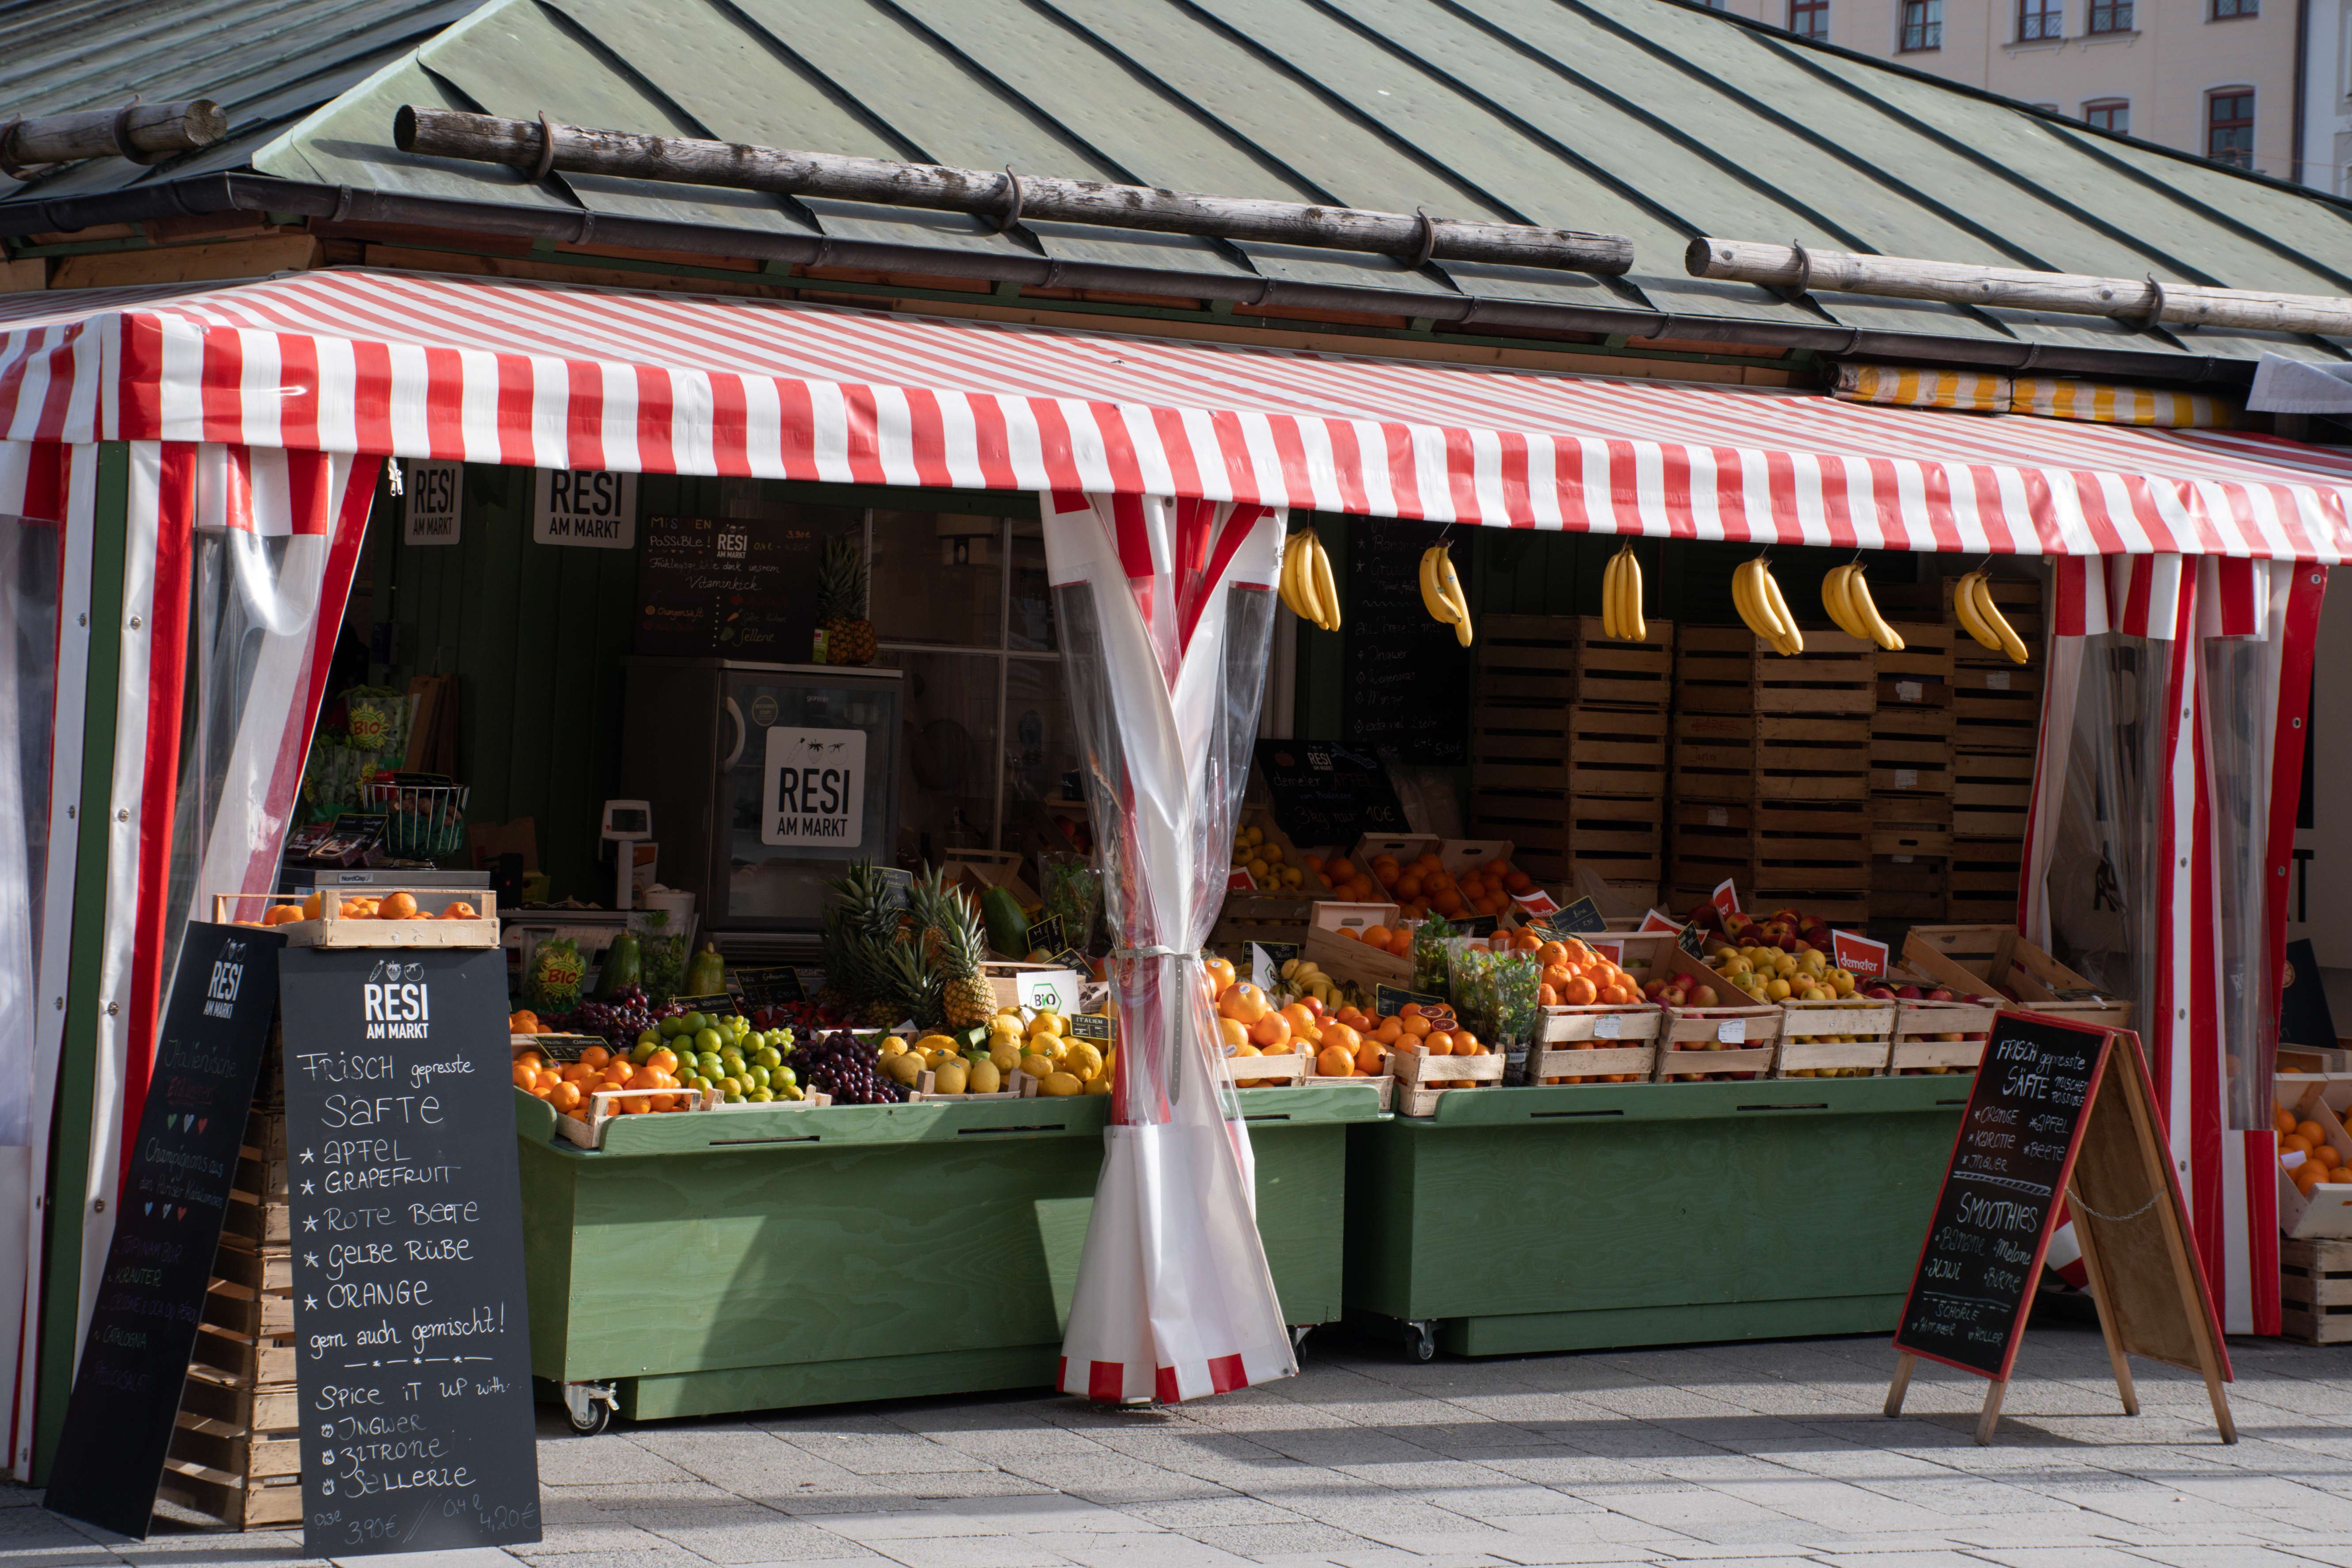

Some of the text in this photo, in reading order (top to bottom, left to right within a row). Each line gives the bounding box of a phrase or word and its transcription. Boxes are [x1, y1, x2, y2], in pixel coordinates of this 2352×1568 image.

[414, 469, 455, 514] RESI
[550, 469, 622, 517] RESI
[413, 517, 453, 535] AM MARKT
[549, 518, 620, 539] AM MARKT
[717, 534, 747, 551] RESI
[723, 561, 742, 571] dank
[685, 575, 763, 591] Vitaminkick
[732, 628, 776, 647] Sellerie
[354, 721, 381, 736] BIO
[1307, 752, 1332, 765] RESI
[1273, 771, 1321, 787] demeter
[779, 767, 850, 814] RESI
[776, 817, 848, 837] AM MARKT
[1840, 952, 1879, 973] demeter
[207, 960, 244, 1002] RESI
[548, 969, 577, 984] BIO
[203, 1000, 234, 1019] AM MARKT
[364, 984, 429, 1021] RESI
[367, 1023, 429, 1039] AM MARKT
[1997, 1039, 2086, 1075] FRISCH gepresste
[411, 1054, 475, 1088] gepresste
[2002, 1065, 2050, 1099] SÄFTE
[145, 1137, 209, 1182] Champignons
[325, 1166, 461, 1194] GRAPEFRUIT
[1936, 1303, 1981, 1322] SCHORLE
[310, 1332, 347, 1360] gern
[356, 1319, 401, 1346] auch
[344, 1514, 401, 1545] 3,90€
[479, 1501, 541, 1533] 4,20€
